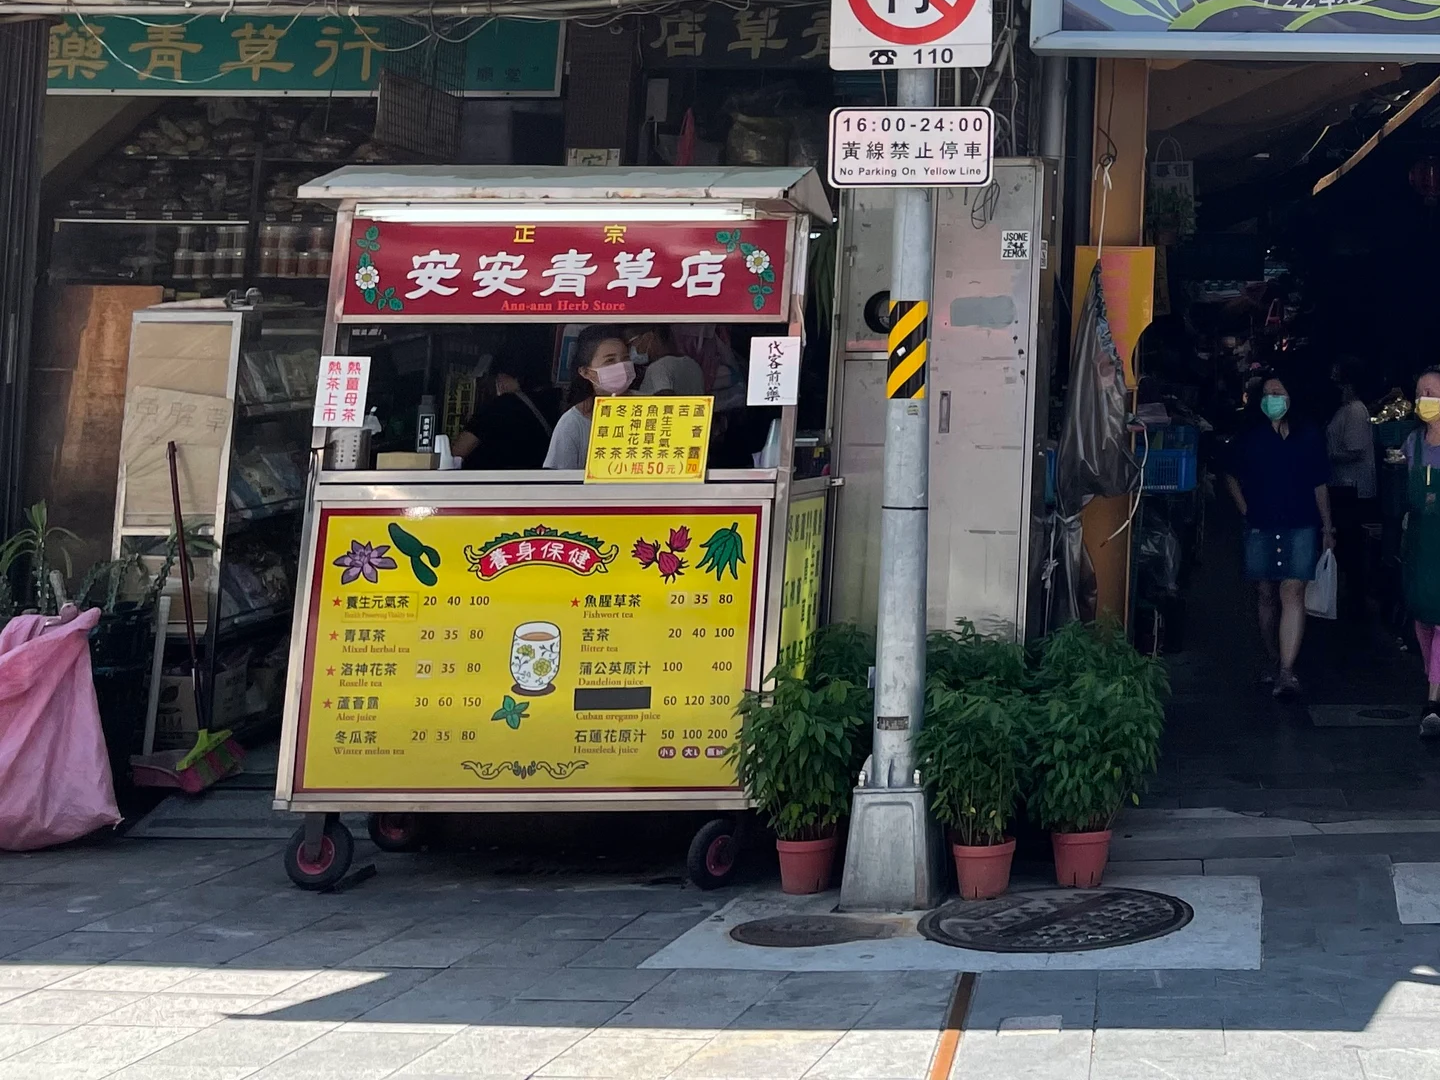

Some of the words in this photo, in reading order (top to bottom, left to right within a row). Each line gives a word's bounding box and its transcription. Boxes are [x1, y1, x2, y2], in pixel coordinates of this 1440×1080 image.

[47, 22, 386, 82] 藥青草行
[913, 48, 953, 64] 110
[843, 117, 983, 133] 16:00-24:00
[842, 141, 982, 160] 黃線禁止停車
[839, 167, 854, 176] No
[858, 167, 897, 177] Parking
[902, 167, 916, 176] On
[923, 167, 956, 176] Yellow
[960, 166, 981, 175] Line
[405, 248, 727, 300] 安安青草店
[501, 299, 552, 311] Ann-ann
[557, 299, 589, 311] Herb
[592, 300, 626, 311] Store
[763, 340, 784, 402] 代客煎藥
[322, 361, 342, 421] 熱茶上市
[341, 361, 361, 422] 熱薑母茶
[594, 404, 611, 460] 青草茶
[609, 404, 627, 460] 冬瓜茶
[626, 404, 643, 460] 洛神花茶
[489, 541, 591, 570] 養身保健
[423, 596, 437, 606] 20
[447, 596, 460, 606] 40
[469, 596, 489, 606] 100
[584, 594, 641, 608] 魚腥草茶
[670, 595, 684, 604] 20
[694, 595, 708, 604] 35
[719, 594, 733, 604] 80
[583, 610, 619, 619] Fishwort
[622, 611, 633, 619] tea
[344, 629, 386, 642] 青草茶
[582, 628, 610, 642] 苦茶
[342, 645, 367, 653] Mixed
[370, 645, 396, 653] herbal
[581, 644, 605, 652] Bitter
[341, 662, 397, 676] 洛神花茶
[579, 661, 651, 675] 蒲公英原汁
[662, 662, 682, 671] 100
[712, 661, 732, 671] 400
[339, 679, 368, 687] Roselle
[578, 678, 622, 686] Dandelion
[624, 678, 644, 687] juice
[415, 697, 428, 707] 30
[438, 697, 452, 707] 60
[463, 697, 481, 707] 150
[664, 696, 677, 706] 60
[685, 696, 704, 705] 120
[710, 695, 730, 705] 300
[336, 713, 354, 721] Aloe
[356, 713, 376, 722] juice
[576, 712, 603, 720] Cuban
[605, 714, 638, 722] oregano
[335, 730, 377, 744] 冬瓜茶
[574, 729, 647, 743] 石蓮花原汁
[661, 730, 674, 739] 50
[682, 729, 702, 739] 100
[707, 729, 727, 739] 200
[334, 747, 362, 755] Winter
[364, 747, 390, 755] melon
